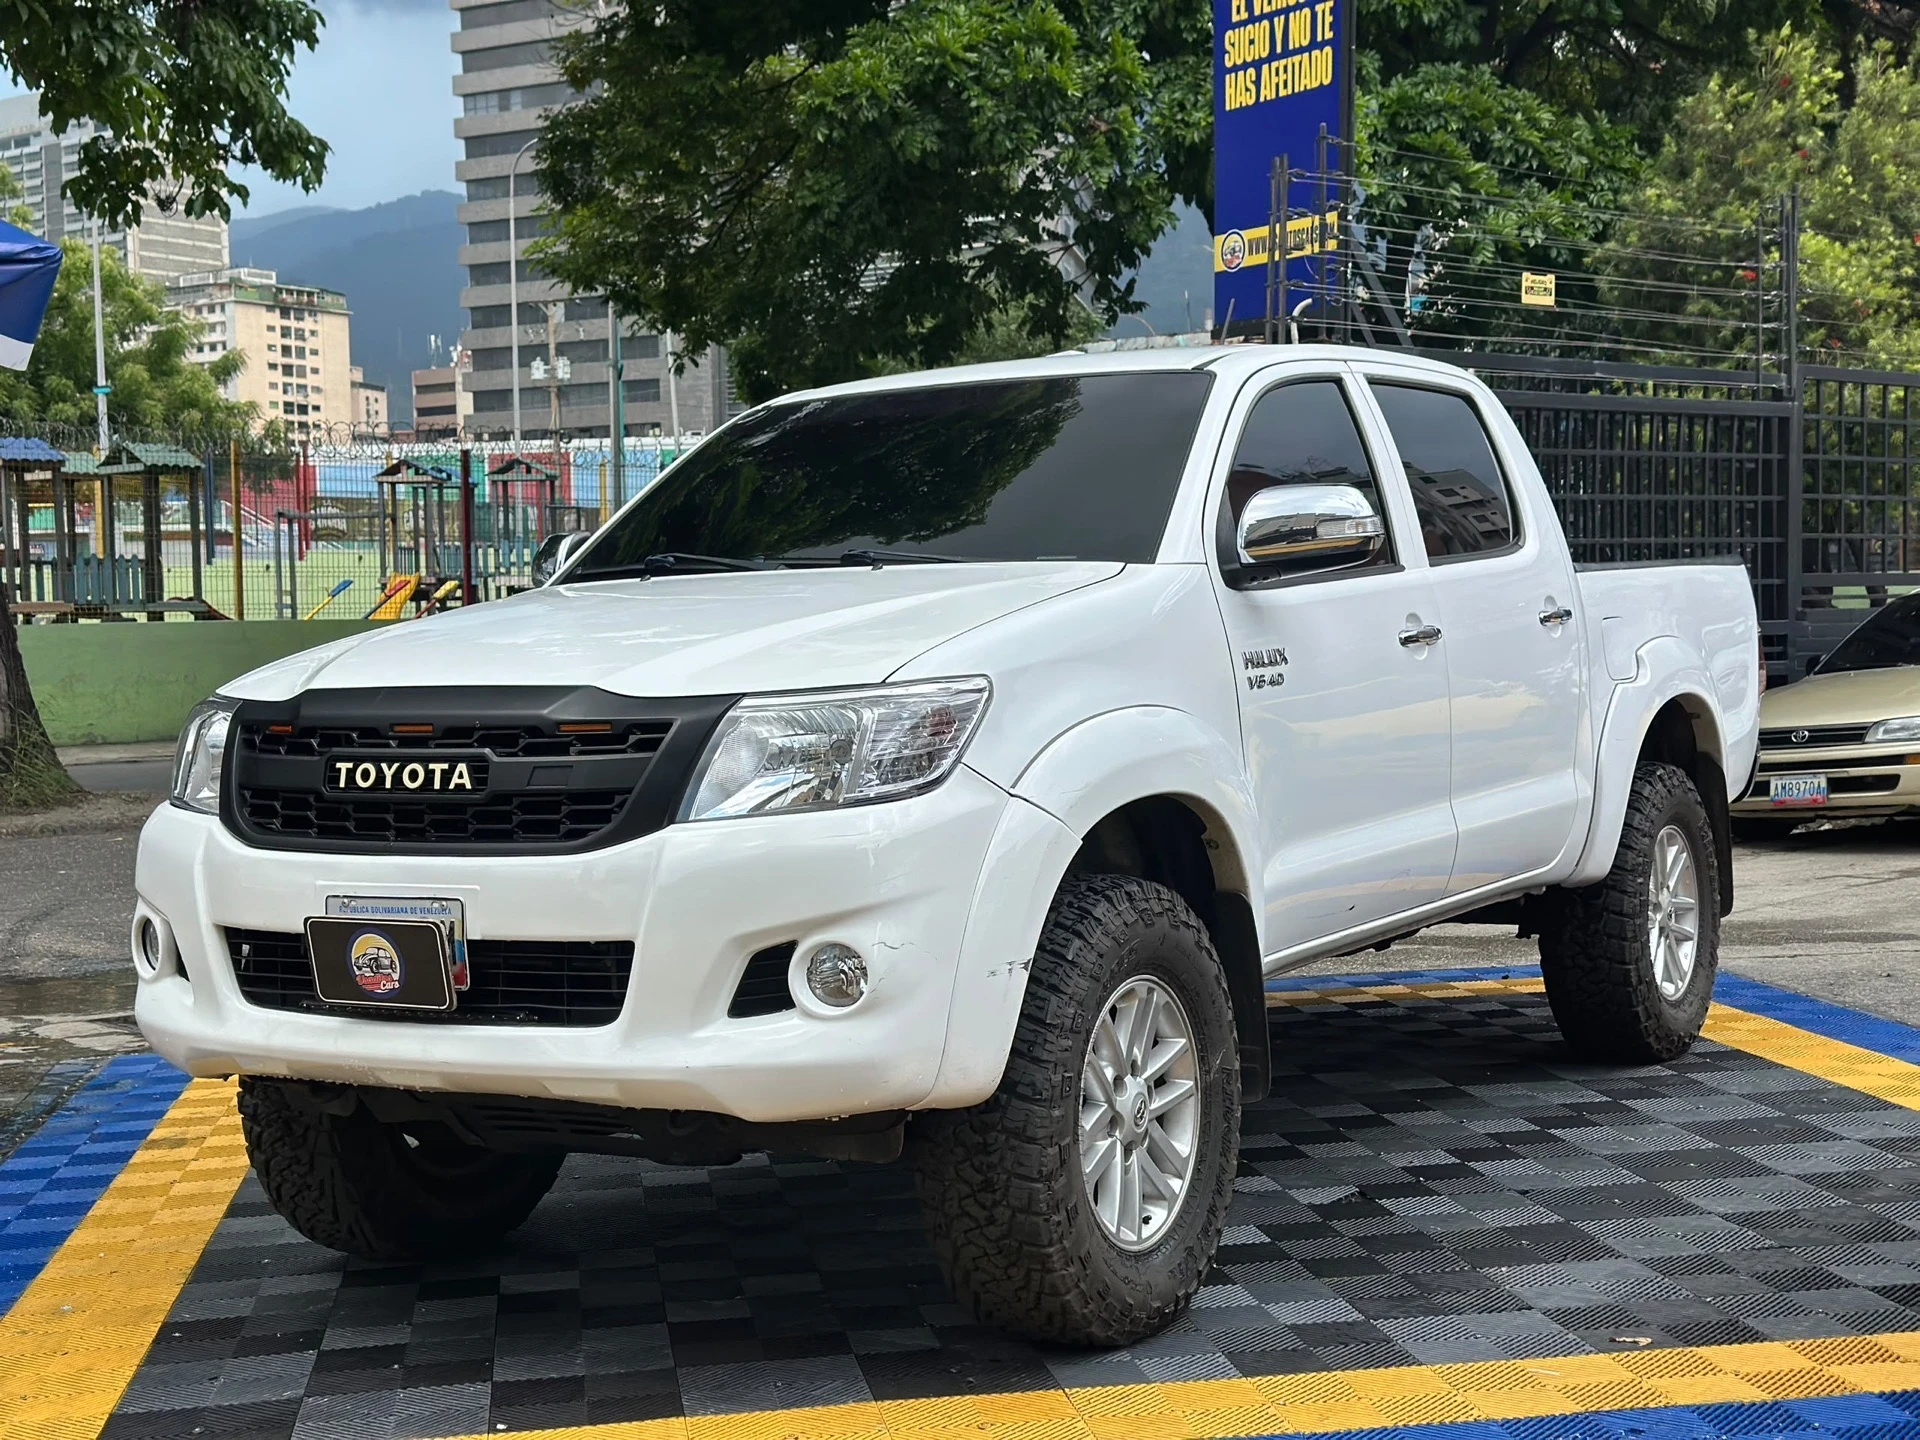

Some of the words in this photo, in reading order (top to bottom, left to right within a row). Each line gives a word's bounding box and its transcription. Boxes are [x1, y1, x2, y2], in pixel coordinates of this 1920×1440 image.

[1224, 19, 1270, 68] SUCIO
[1274, 15, 1285, 54] Y
[1288, 7, 1311, 50] NO
[1315, 1, 1334, 42] TE
[1225, 67, 1256, 111] HAS
[1259, 45, 1333, 102] AFEITADO
[1241, 647, 1289, 670] HILUX
[335, 762, 472, 790] TOYOTA
[371, 906, 408, 915] BOLIVARIANA
[410, 907, 417, 915] DE
[419, 906, 452, 916] VENEZUELA
[380, 980, 400, 990] Cars
